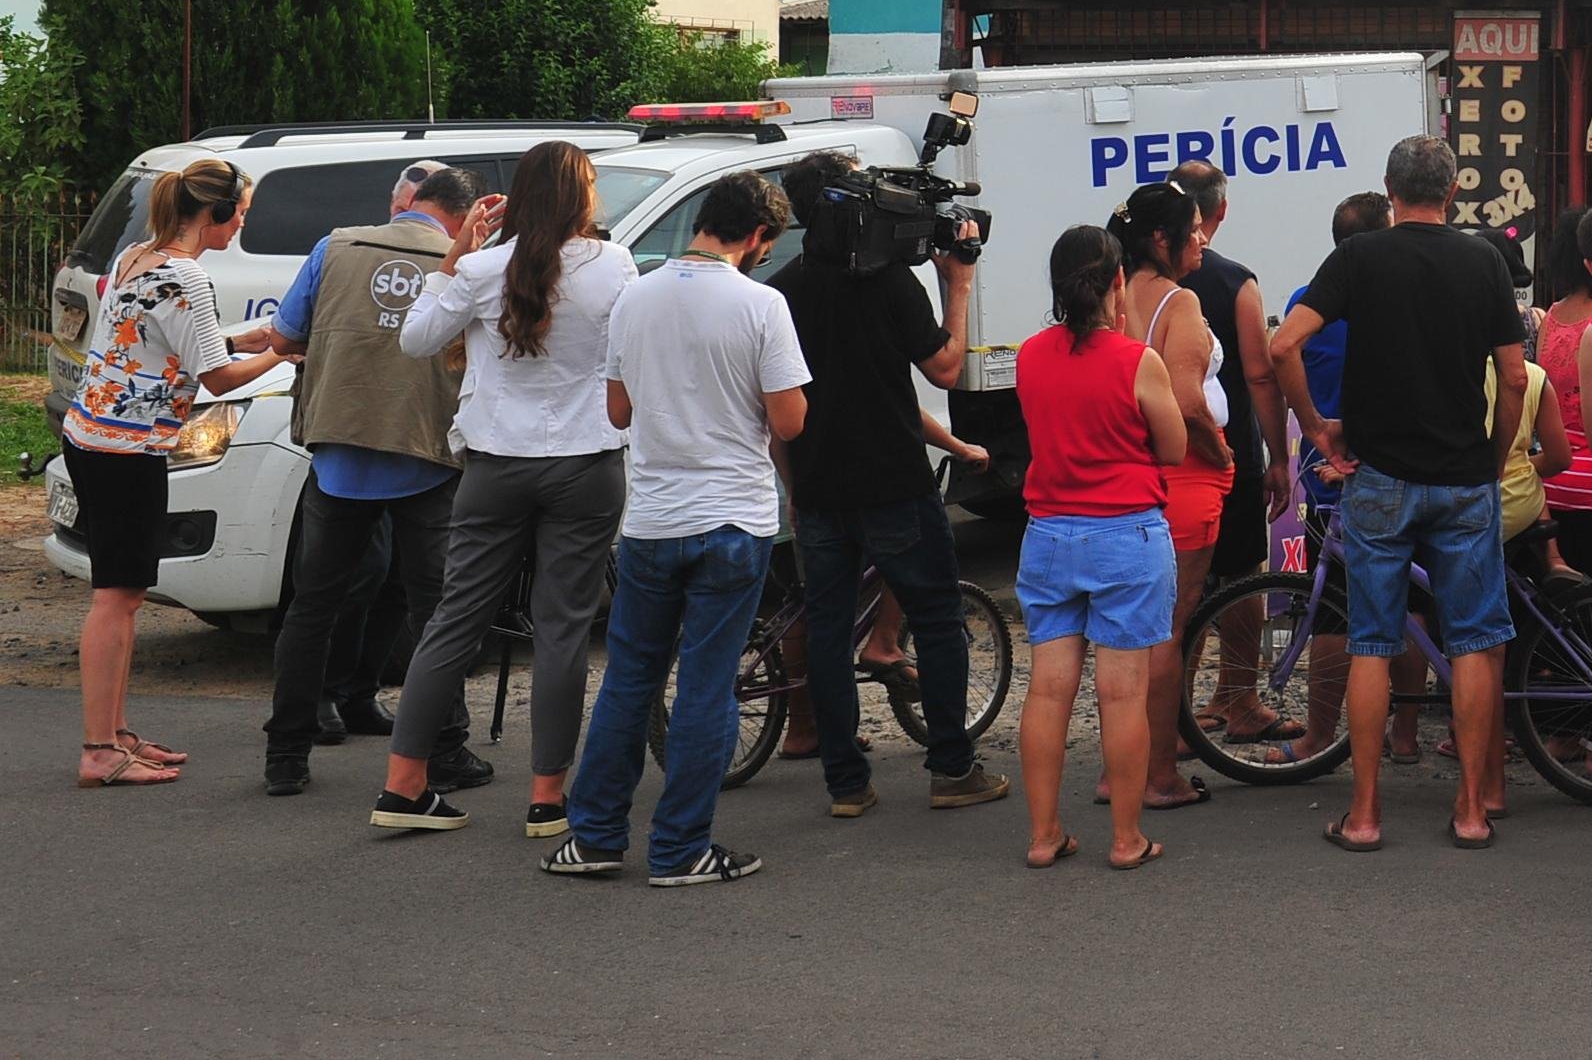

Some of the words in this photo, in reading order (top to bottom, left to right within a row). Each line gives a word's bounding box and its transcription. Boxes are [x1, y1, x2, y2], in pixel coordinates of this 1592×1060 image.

[1455, 22, 1539, 56] AQUI
[1090, 116, 1348, 188] PERÍCIA
[1483, 183, 1536, 229] 3X4
[374, 267, 422, 299] sbt
[243, 298, 280, 322] IG
[377, 312, 401, 329] RS
